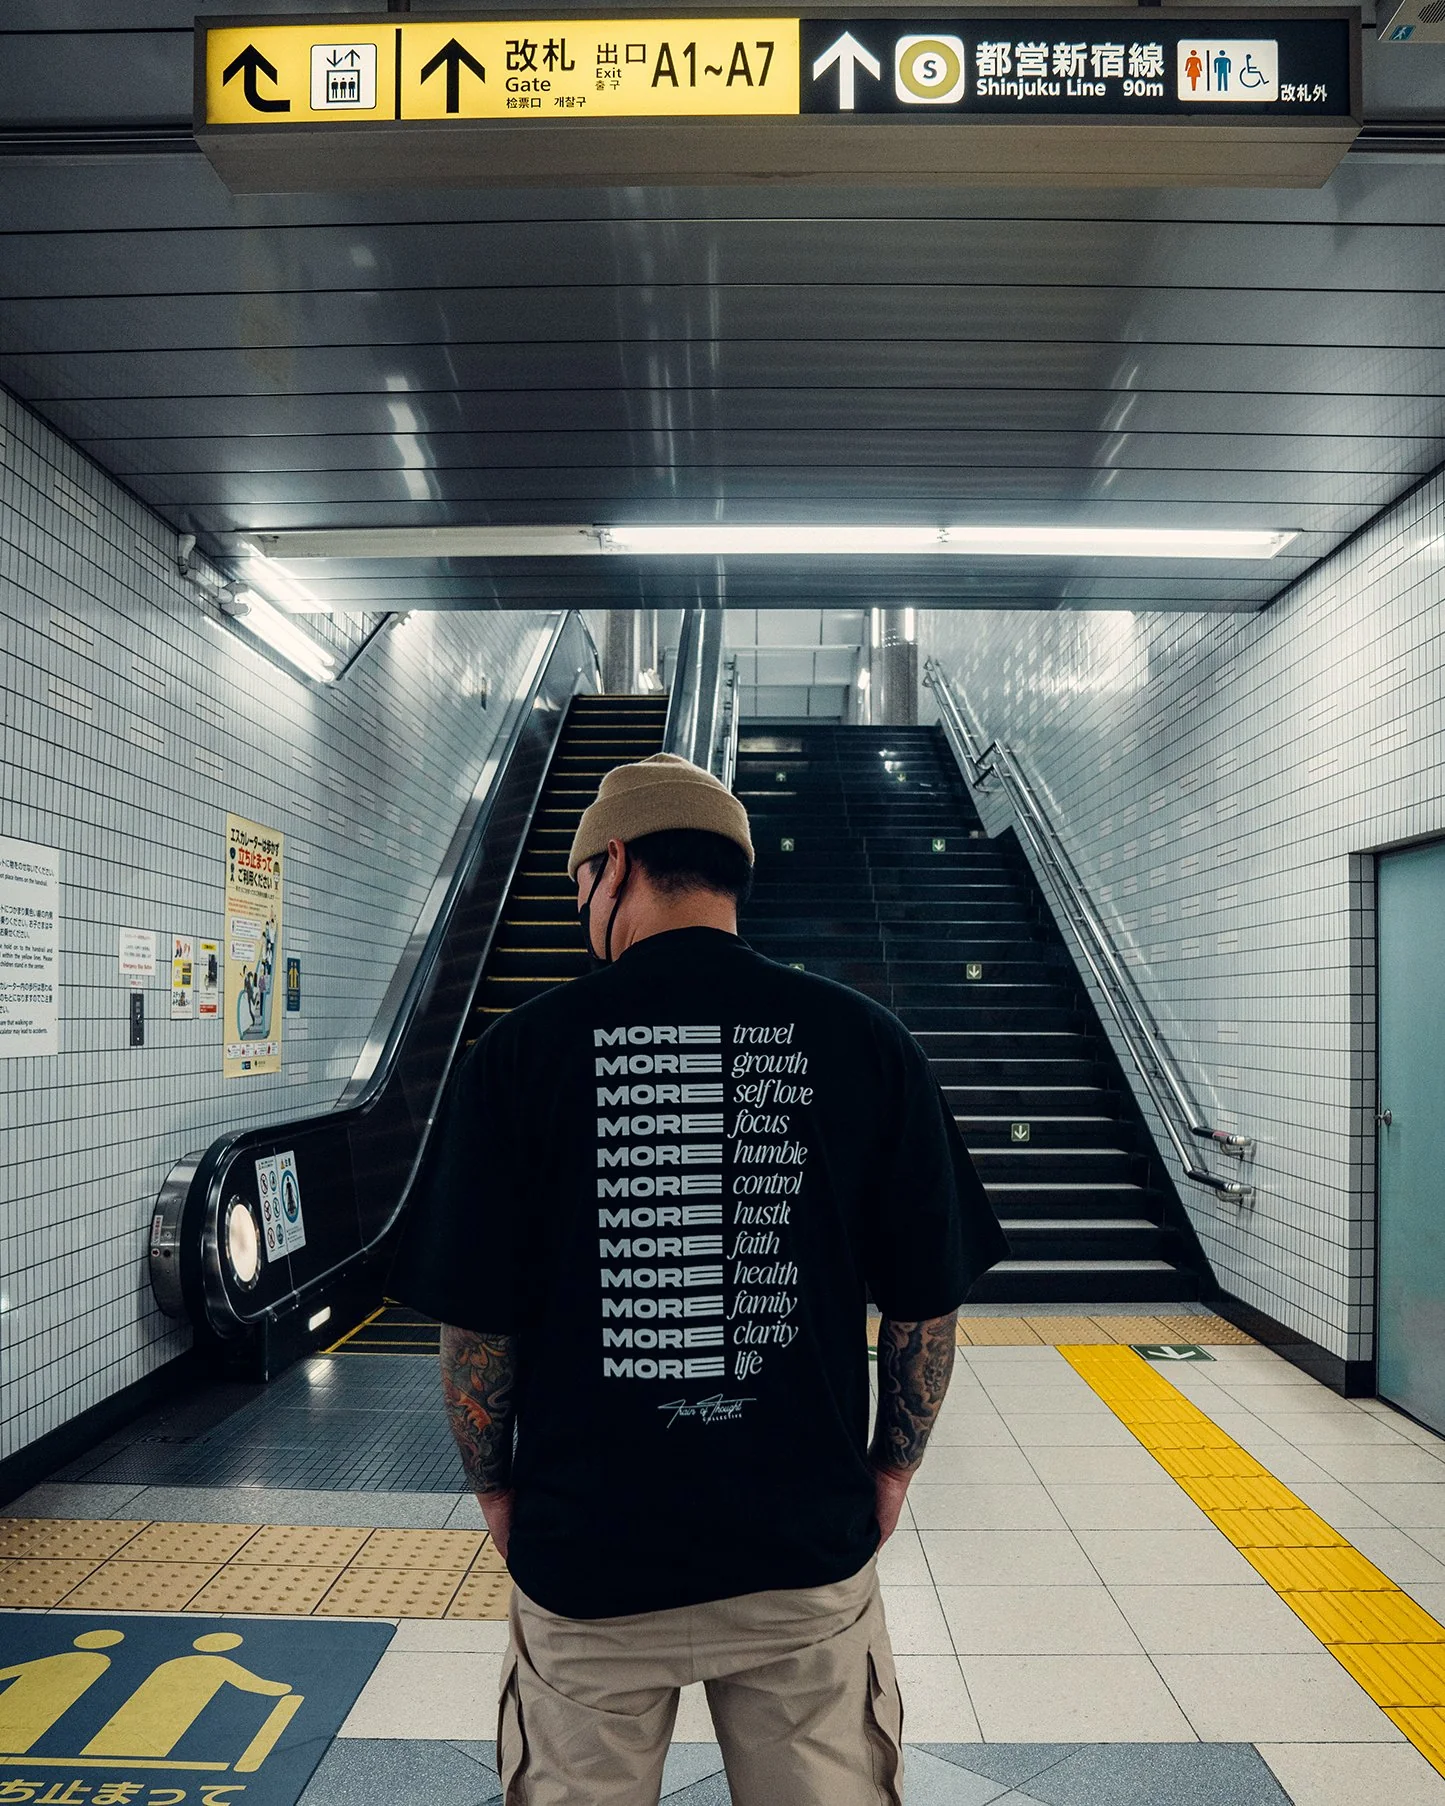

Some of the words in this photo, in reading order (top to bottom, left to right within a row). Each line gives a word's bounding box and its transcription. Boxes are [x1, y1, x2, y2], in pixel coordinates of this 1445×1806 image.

[506, 38, 575, 73] 改札
[597, 43, 647, 65] 出口
[976, 41, 1165, 78] 都営新宿線
[505, 77, 551, 93] Gate
[596, 68, 622, 79] Exit
[923, 60, 937, 79] S
[976, 78, 1054, 100] Shinjuku
[1067, 79, 1106, 97] Line
[1123, 80, 1164, 97] 90m
[1280, 83, 1328, 102] 改札外
[238, 847, 273, 873] 立ち止まって
[238, 868, 273, 890] ご利用ください
[594, 1026, 722, 1046] MORE
[733, 1023, 795, 1044] travel
[596, 1054, 723, 1076] MORE
[731, 1052, 808, 1078] growth
[597, 1083, 723, 1106] MORE
[597, 1114, 723, 1137] MORE
[727, 1109, 789, 1138] focus
[597, 1144, 722, 1167] MORE
[733, 1140, 808, 1164] humble
[598, 1175, 722, 1197] MORE
[733, 1172, 803, 1194] control
[599, 1205, 722, 1228] MORE
[600, 1235, 723, 1257] MORE
[727, 1231, 780, 1260] faith
[601, 1265, 723, 1288] MORE
[733, 1261, 798, 1285] health
[602, 1295, 723, 1318] MORE
[727, 1290, 798, 1320] family
[603, 1326, 724, 1348] MORE
[733, 1321, 799, 1347] clarity
[604, 1356, 724, 1379] MORE
[734, 1350, 763, 1380] life
